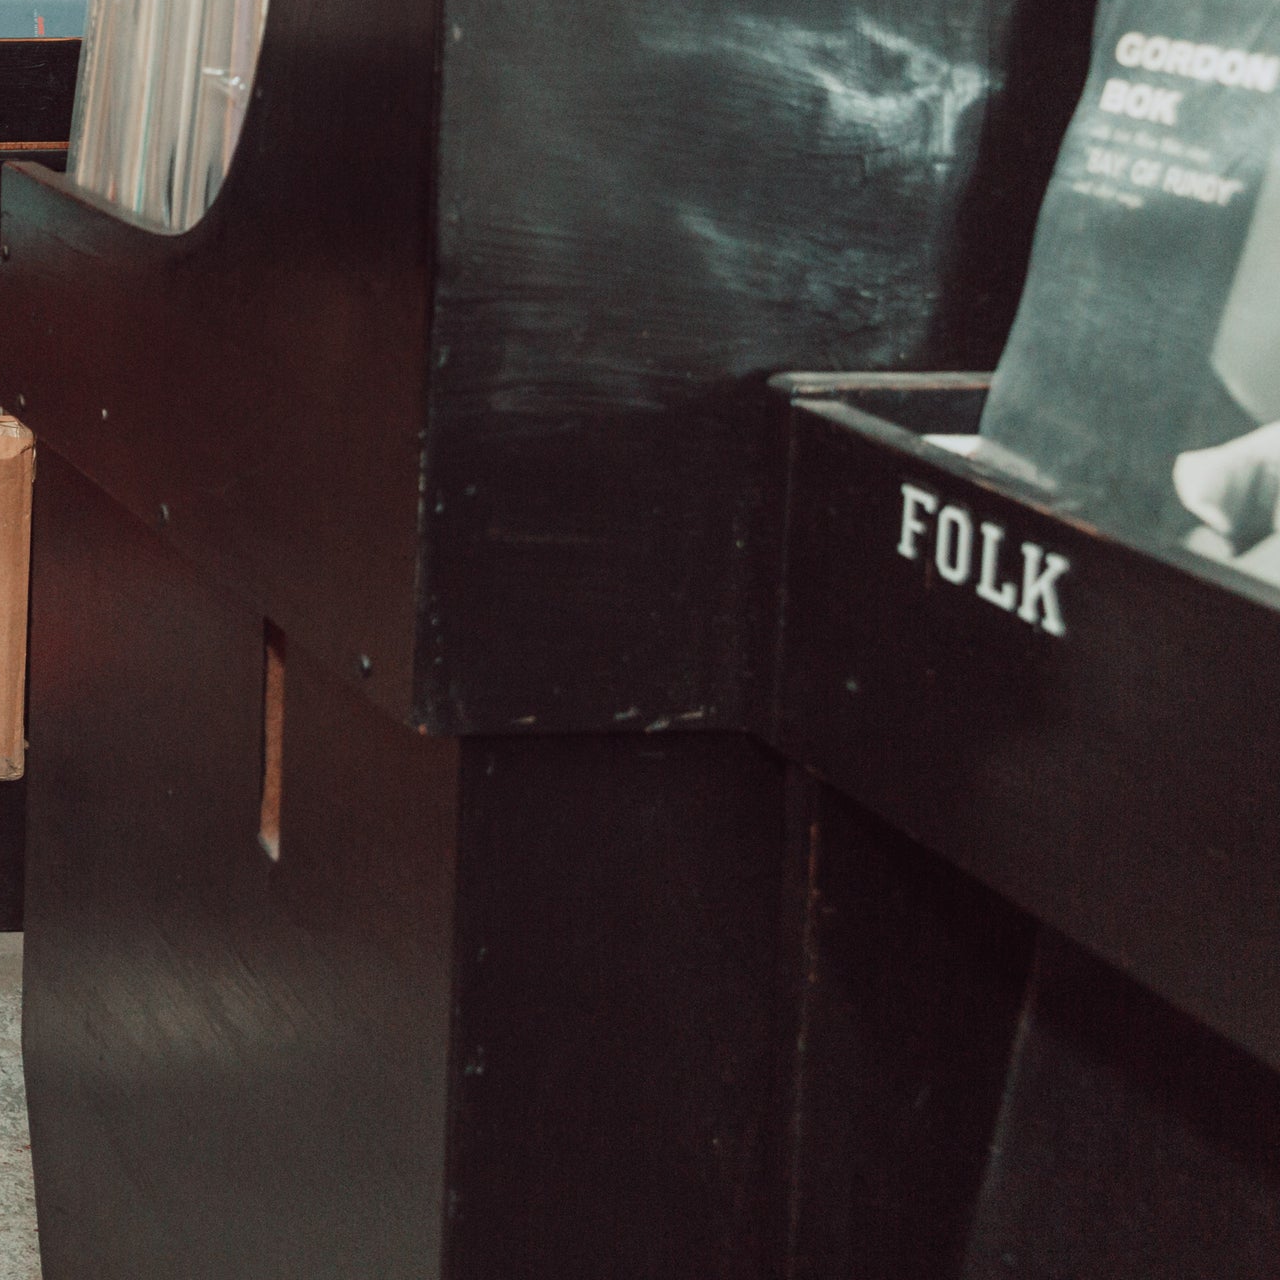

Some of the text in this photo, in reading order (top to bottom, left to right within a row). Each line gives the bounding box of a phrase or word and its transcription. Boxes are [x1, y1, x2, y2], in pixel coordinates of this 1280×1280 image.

[1114, 31, 1278, 94] GORDON
[1100, 78, 1182, 126] BOK
[896, 483, 1071, 637] FOLK
